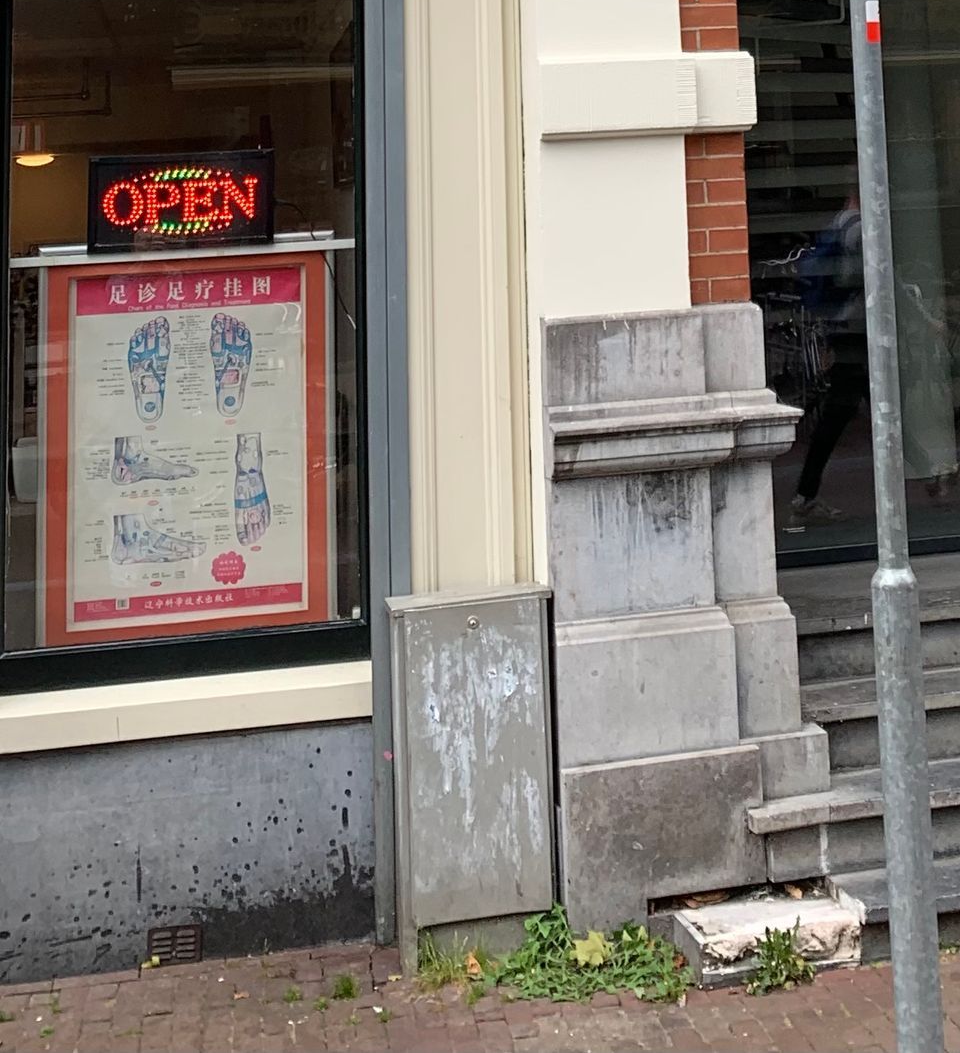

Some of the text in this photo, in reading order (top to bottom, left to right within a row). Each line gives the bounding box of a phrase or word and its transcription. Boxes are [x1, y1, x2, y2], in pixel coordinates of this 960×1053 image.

[102, 176, 258, 227] OPEN
[108, 276, 271, 306] 足诊足疗挂图
[181, 300, 209, 309] Diagnosis
